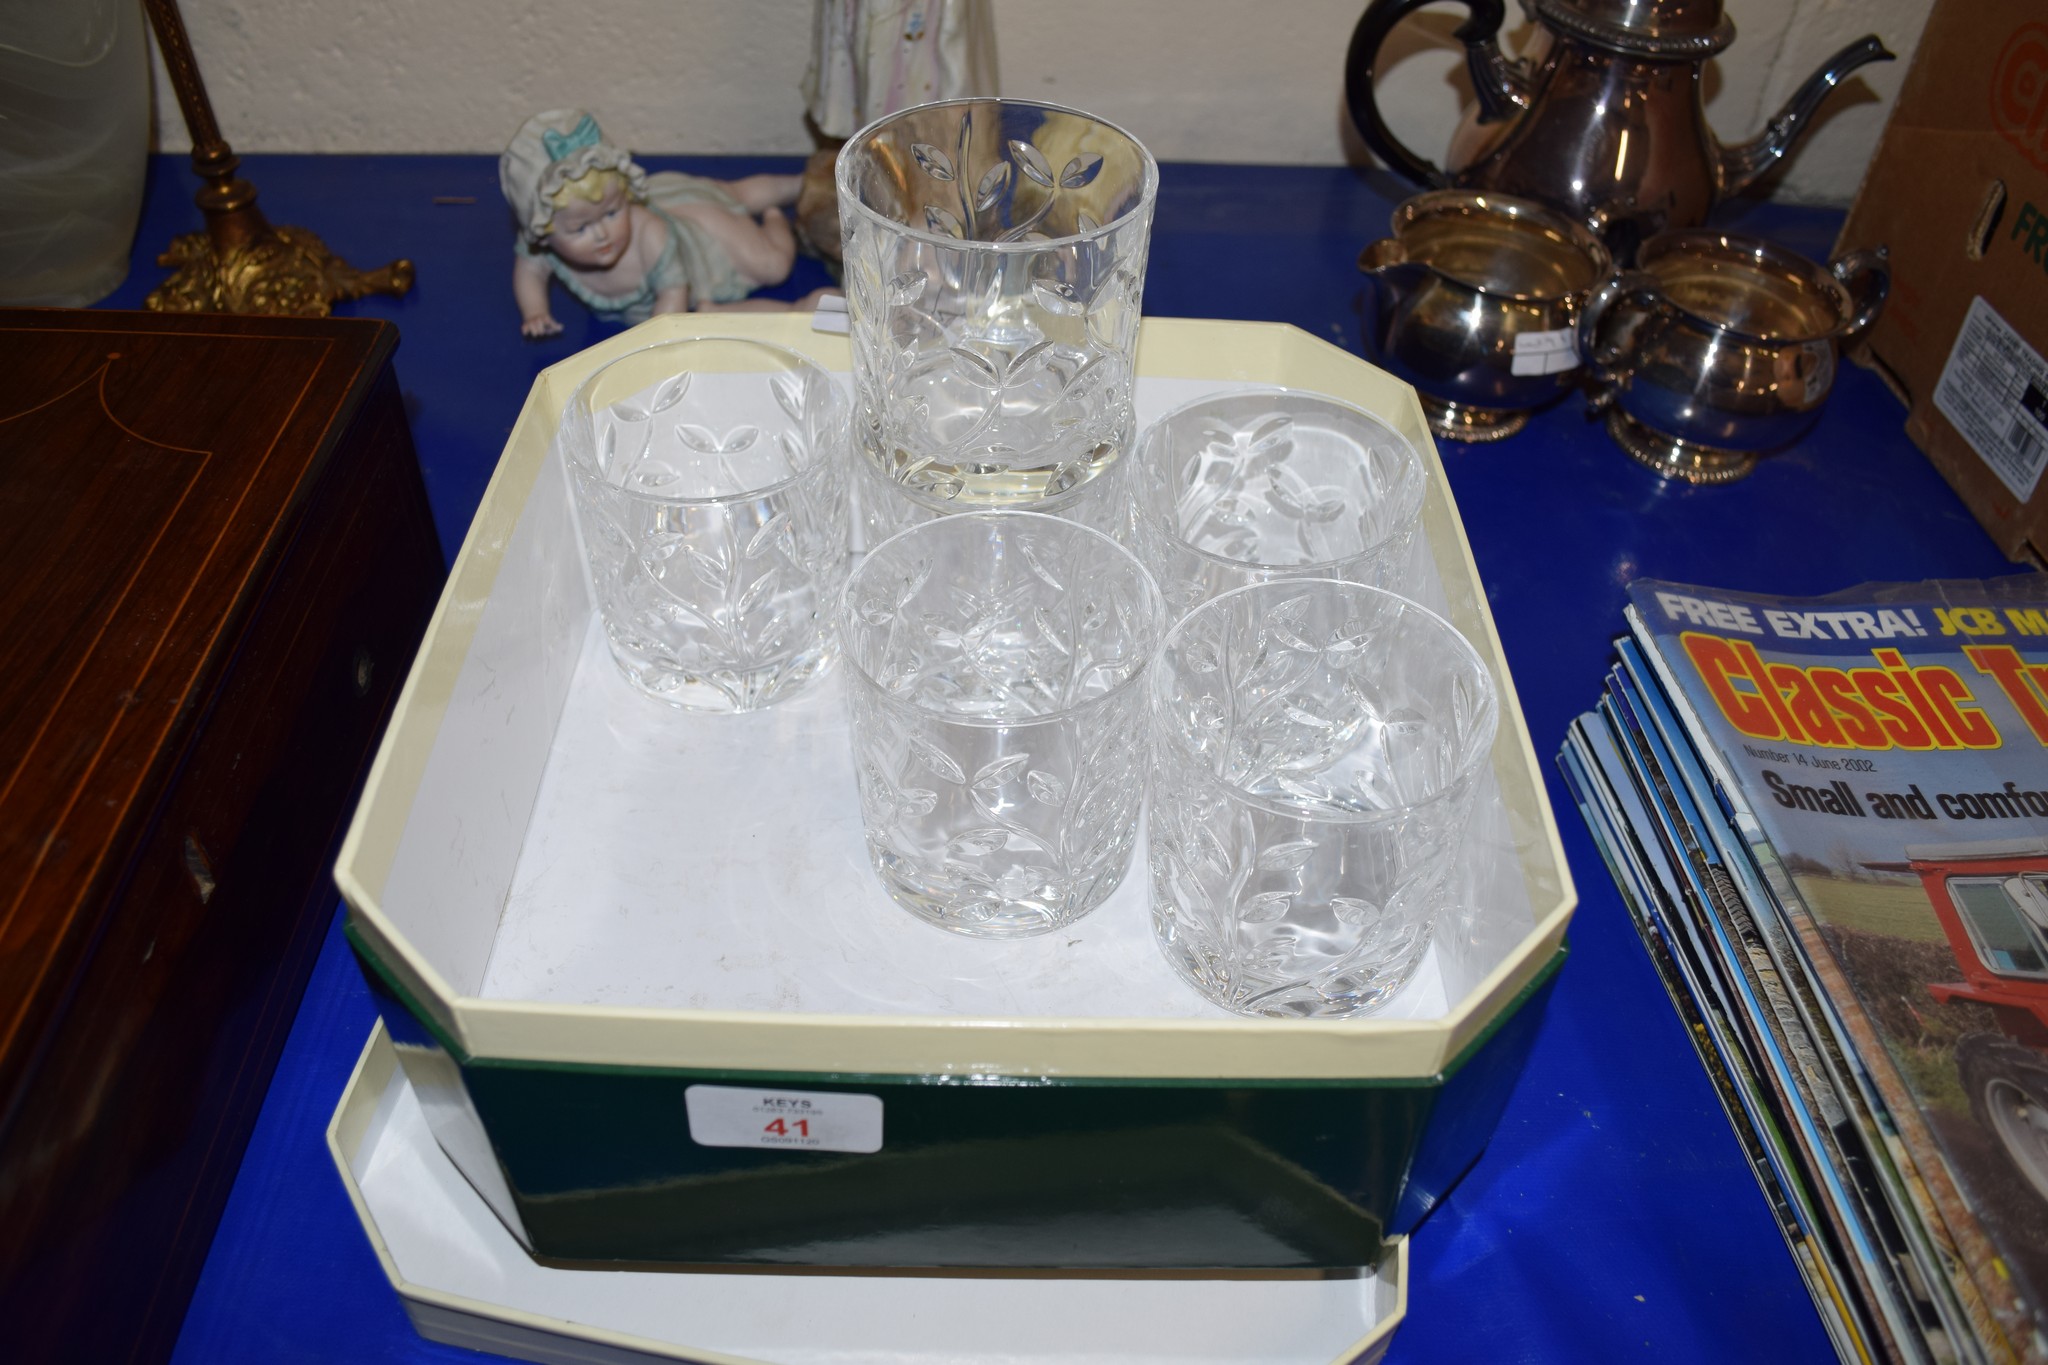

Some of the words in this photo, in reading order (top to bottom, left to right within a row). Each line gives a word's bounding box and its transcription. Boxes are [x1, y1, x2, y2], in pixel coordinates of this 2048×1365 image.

[2011, 202, 2048, 275] FR
[1655, 591, 1764, 634] FREE
[1763, 609, 1928, 640] EXTRA!
[1933, 607, 2006, 637] JCB
[2004, 608, 2048, 637] M
[1679, 630, 2003, 751] Classic
[1743, 744, 1790, 764] Number
[1793, 752, 1808, 767] 14
[1811, 756, 1841, 770] June
[1841, 759, 1878, 773] 2002
[1762, 770, 1867, 818] Small
[1866, 784, 1938, 820] and
[1936, 781, 2048, 820] comfo
[763, 1098, 812, 1109] KEYS
[764, 1117, 809, 1137] 41
